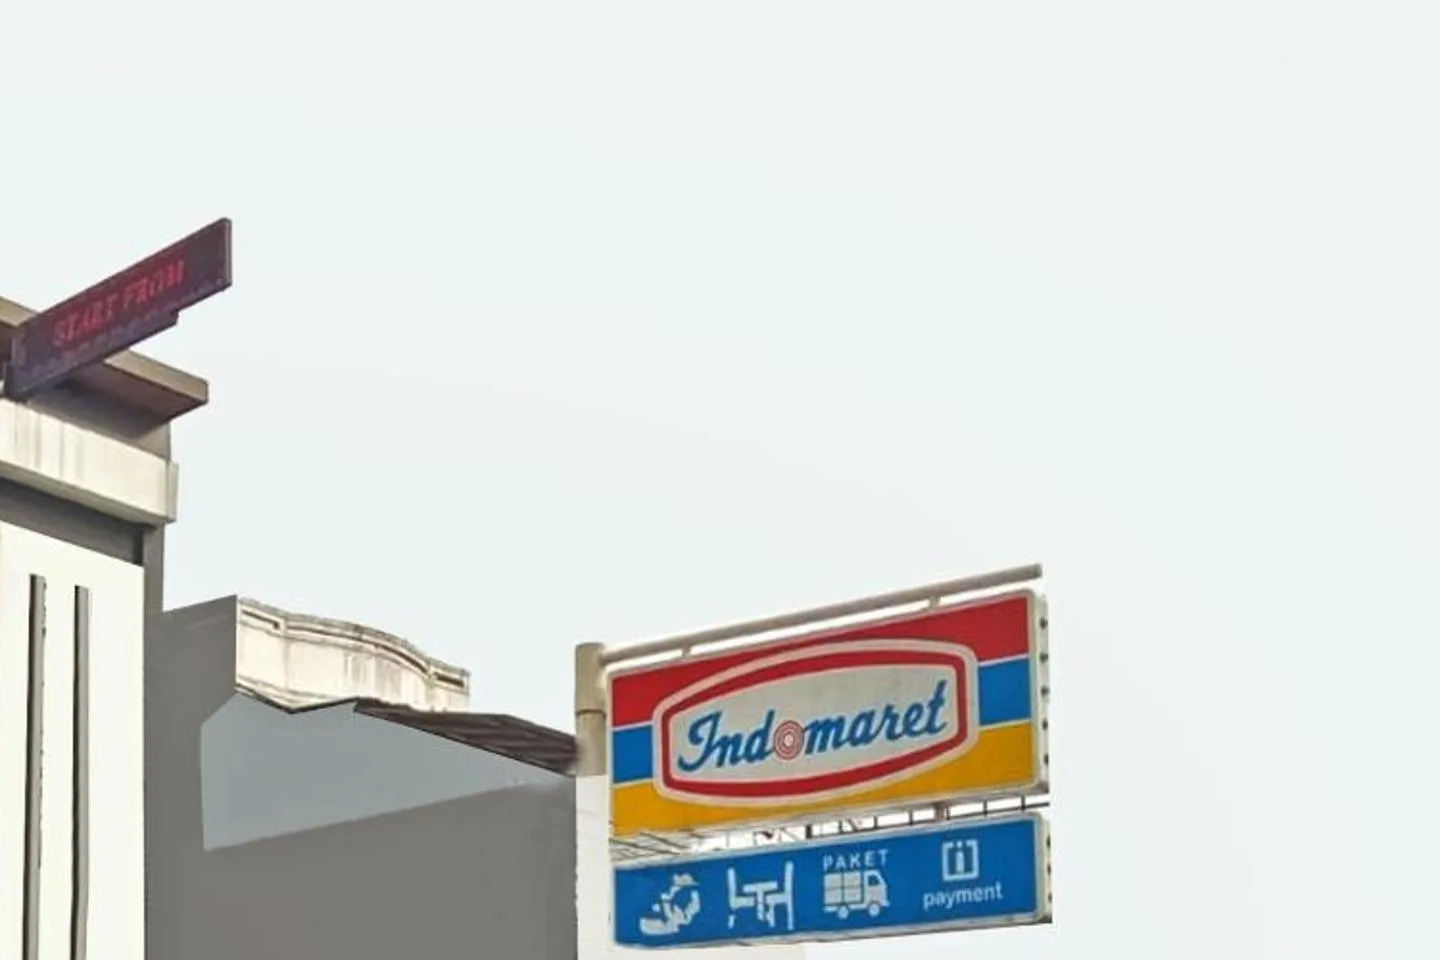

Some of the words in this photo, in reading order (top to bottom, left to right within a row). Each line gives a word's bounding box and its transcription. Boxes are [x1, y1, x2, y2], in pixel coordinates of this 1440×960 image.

[676, 678, 949, 773] Indomaret
[822, 849, 890, 871] PAKET
[922, 881, 1004, 911] payment
